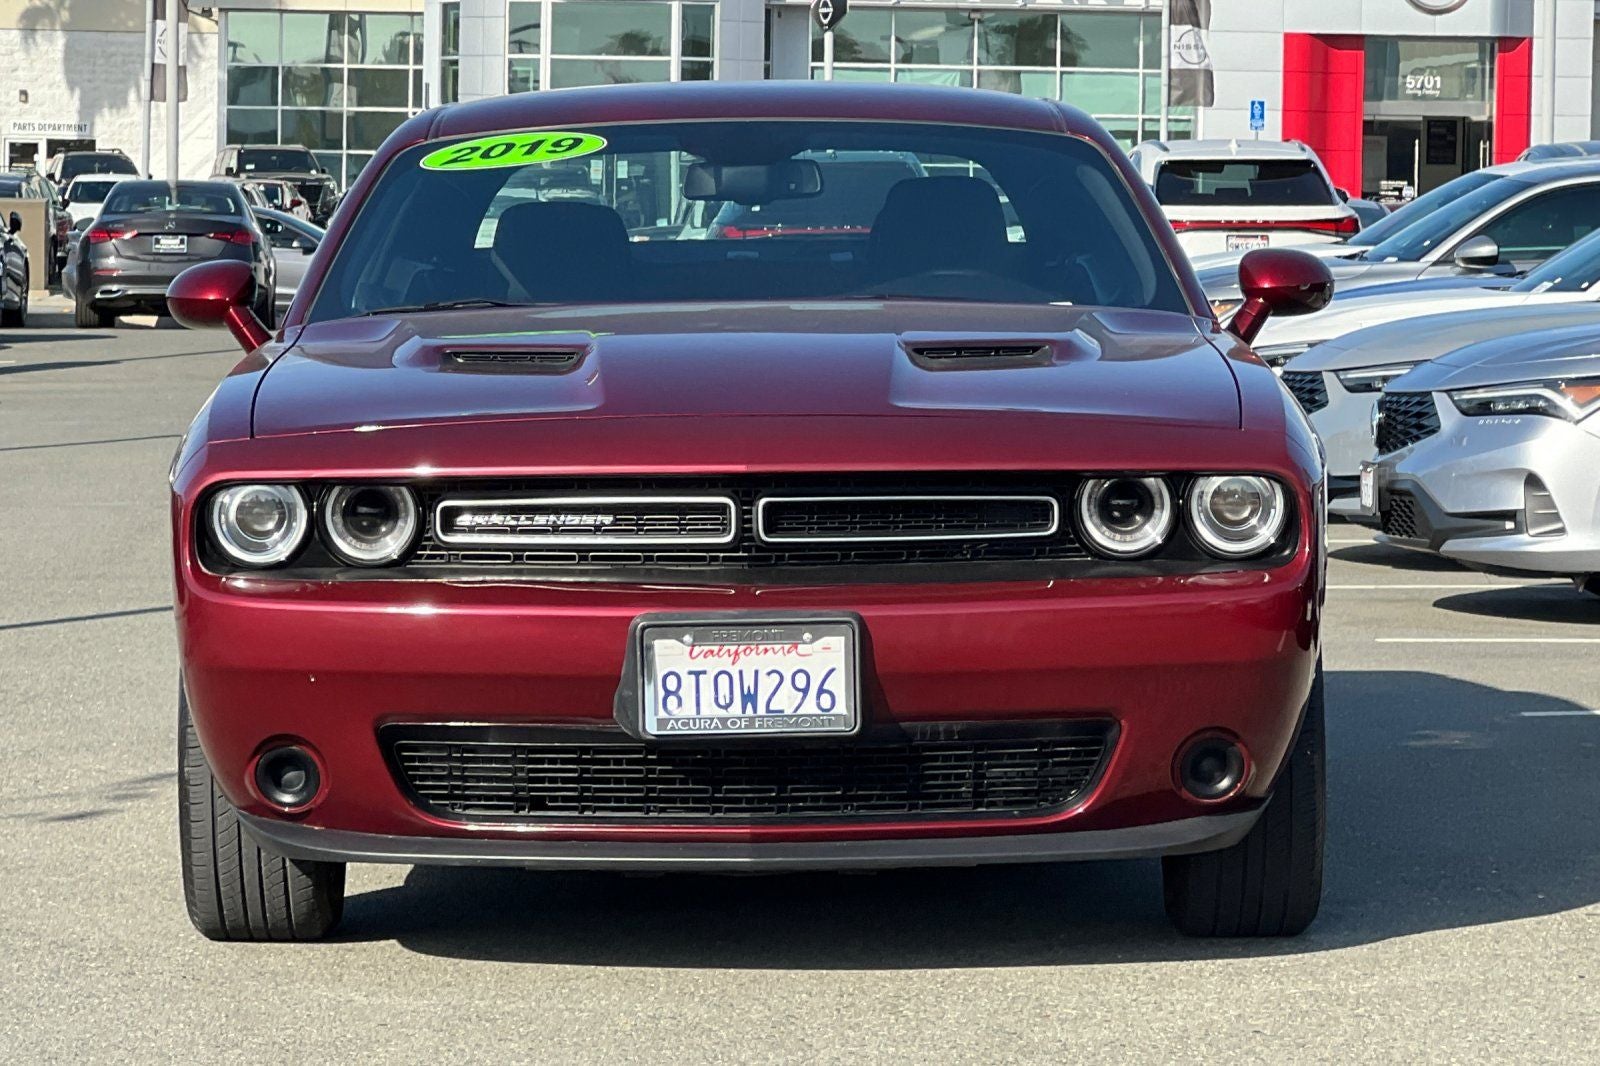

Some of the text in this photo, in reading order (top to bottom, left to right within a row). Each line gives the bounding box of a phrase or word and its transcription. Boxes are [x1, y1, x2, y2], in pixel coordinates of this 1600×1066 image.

[1406, 75, 1441, 89] 5701
[12, 122, 88, 133] PARTS DEPARTMENT
[440, 137, 585, 166] 2019
[711, 629, 785, 641] FREMONT
[688, 643, 813, 666] California
[661, 667, 837, 716] 8TQW296
[666, 716, 835, 730] ACURA OF FREMONT
